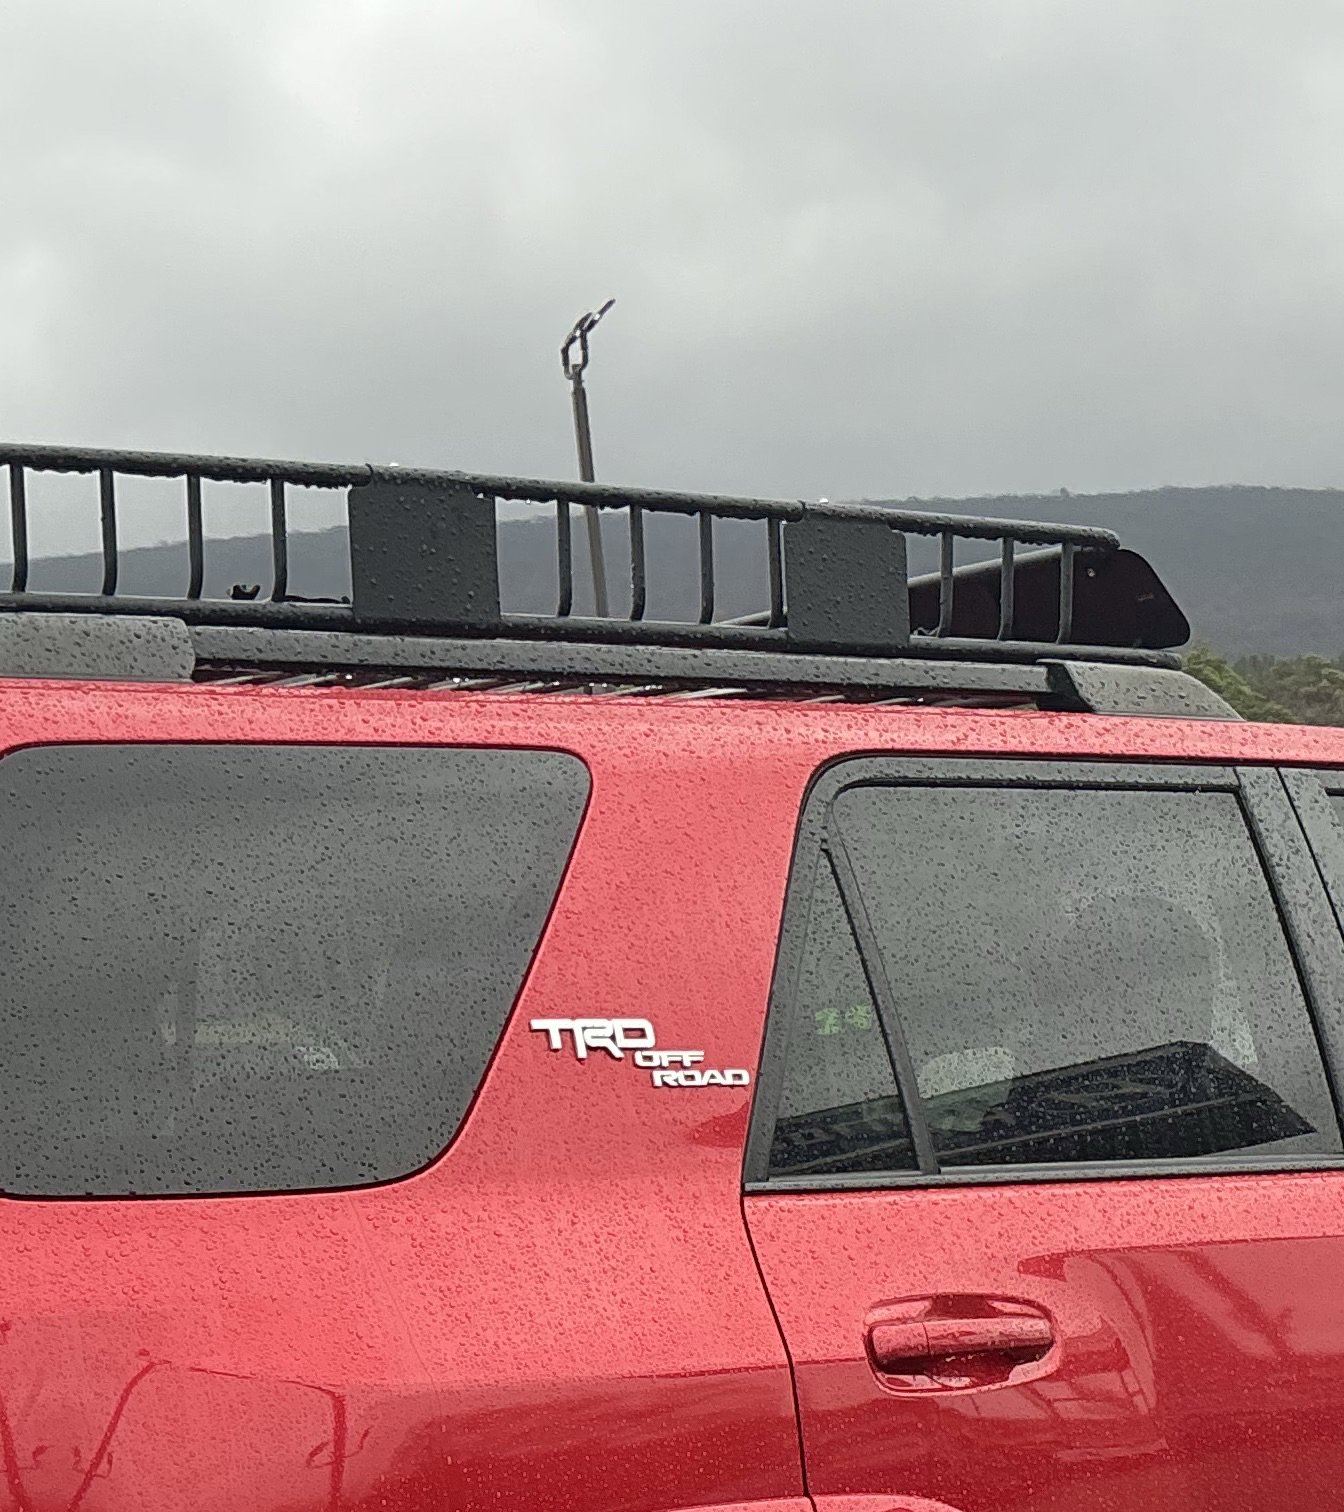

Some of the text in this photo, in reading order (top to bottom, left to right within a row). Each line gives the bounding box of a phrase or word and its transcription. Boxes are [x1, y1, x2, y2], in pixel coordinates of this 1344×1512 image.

[530, 1018, 656, 1059] TRD
[634, 1050, 705, 1067] OFF
[652, 1069, 750, 1087] ROAD
